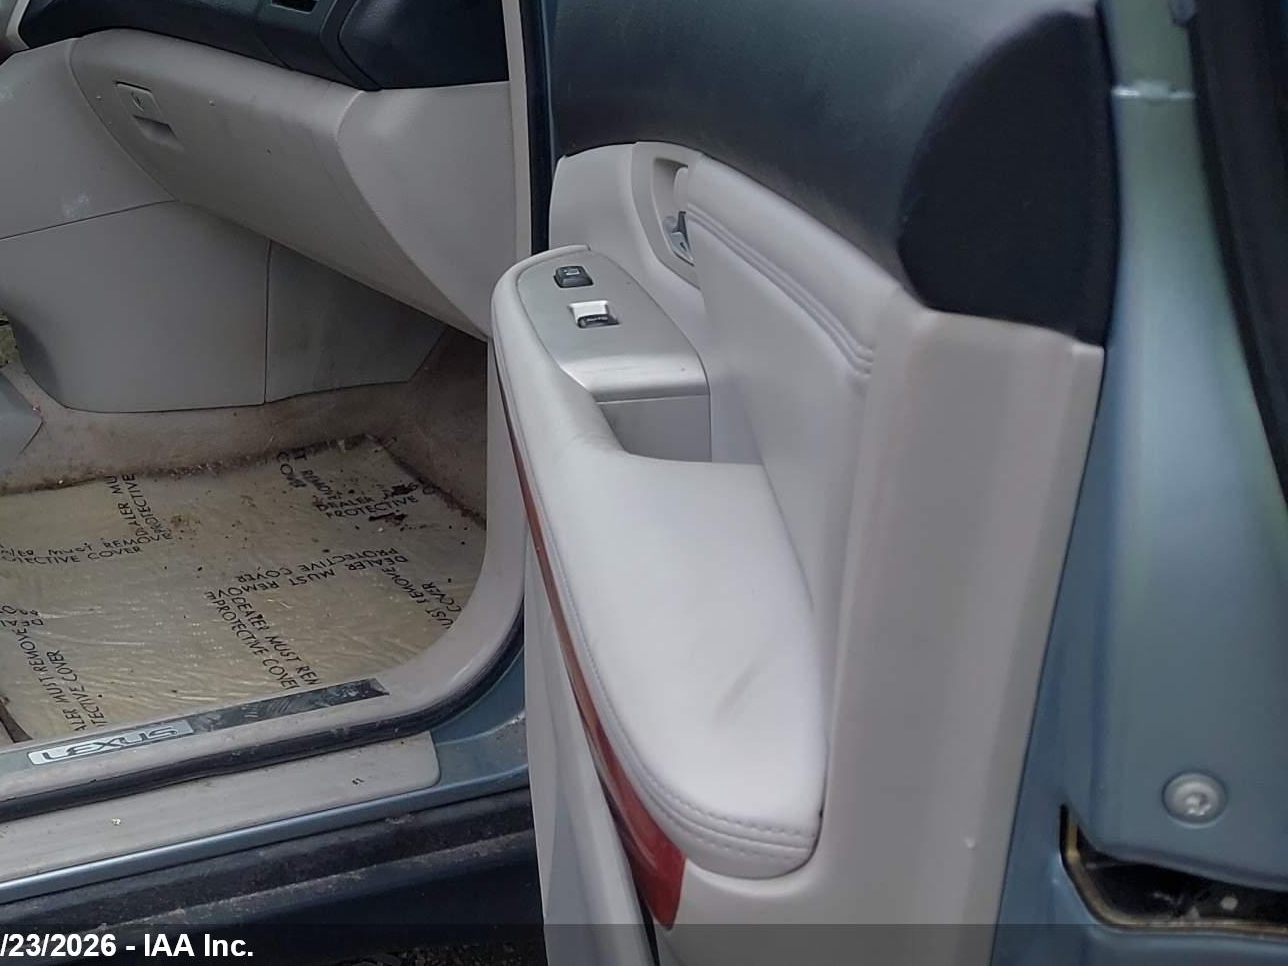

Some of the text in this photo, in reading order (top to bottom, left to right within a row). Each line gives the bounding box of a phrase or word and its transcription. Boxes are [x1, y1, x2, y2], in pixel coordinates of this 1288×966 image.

[87, 545, 143, 560] COVER
[103, 530, 174, 550] REMOVE
[236, 547, 399, 583] PROTECTIVE COVER
[290, 568, 335, 587] MUST
[346, 554, 409, 572] DEALER
[213, 598, 268, 657] PROTECTIVE
[13, 628, 49, 674] REMOVE
[264, 634, 302, 663] MUST
[38, 675, 70, 704] MUST
[46, 650, 109, 727] TECTIVE COVER
[42, 726, 179, 761] LEXUS
